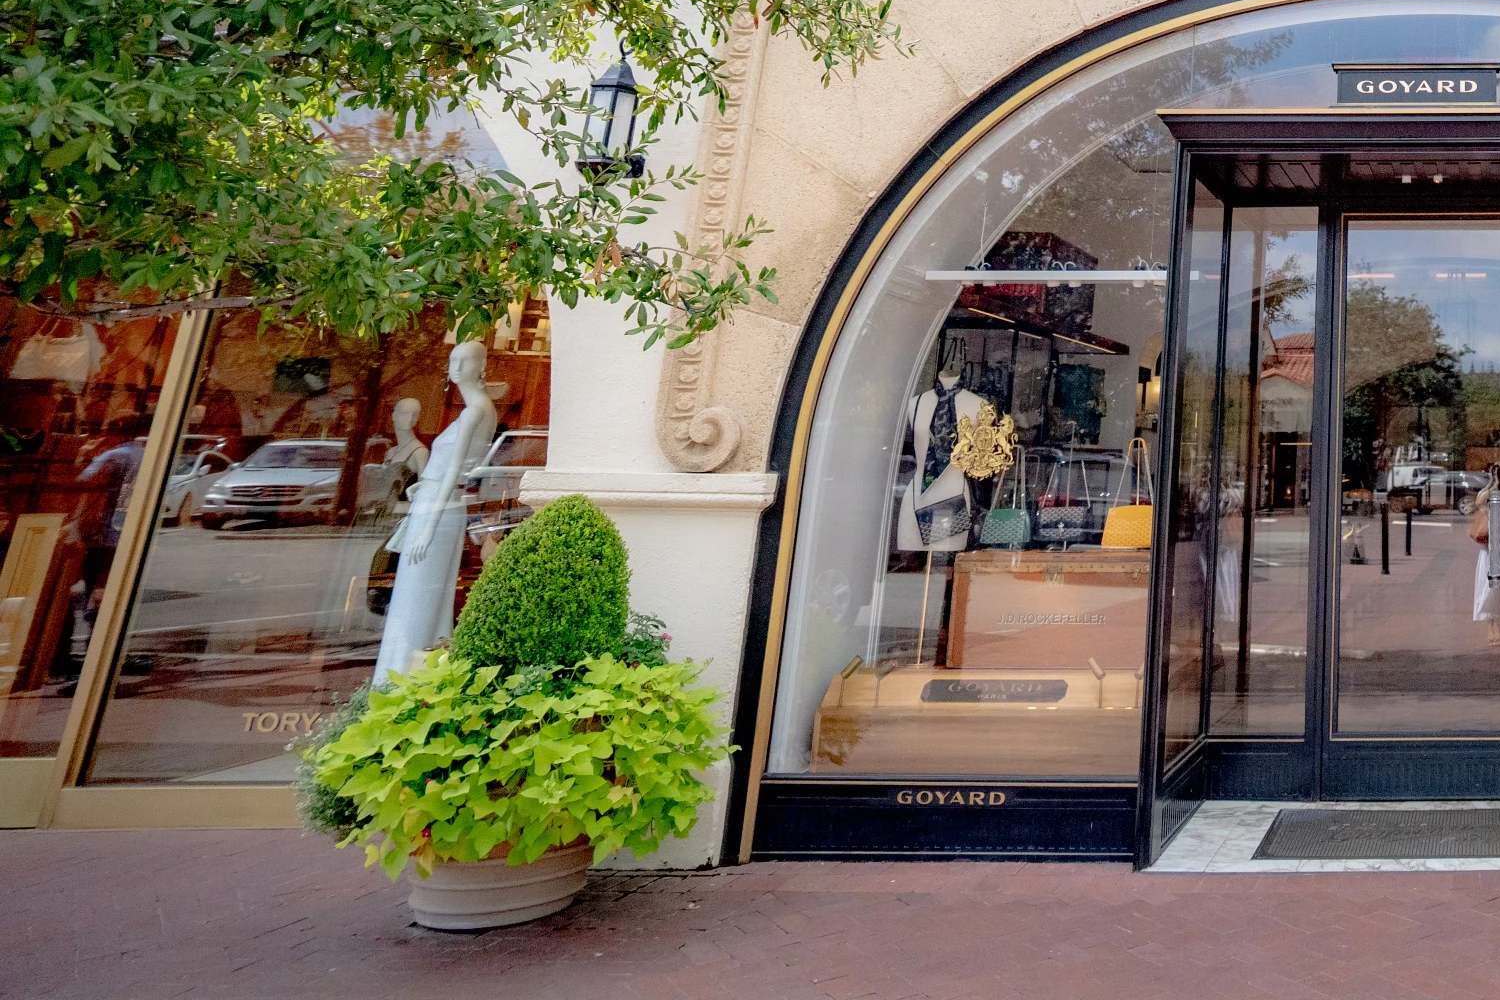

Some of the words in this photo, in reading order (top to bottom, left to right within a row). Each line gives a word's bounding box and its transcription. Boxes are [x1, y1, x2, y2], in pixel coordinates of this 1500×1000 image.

[1356, 79, 1479, 94] GOYARD
[948, 682, 1043, 693] GOYARD
[241, 711, 322, 733] TORY
[896, 790, 1006, 806] GOYARD
